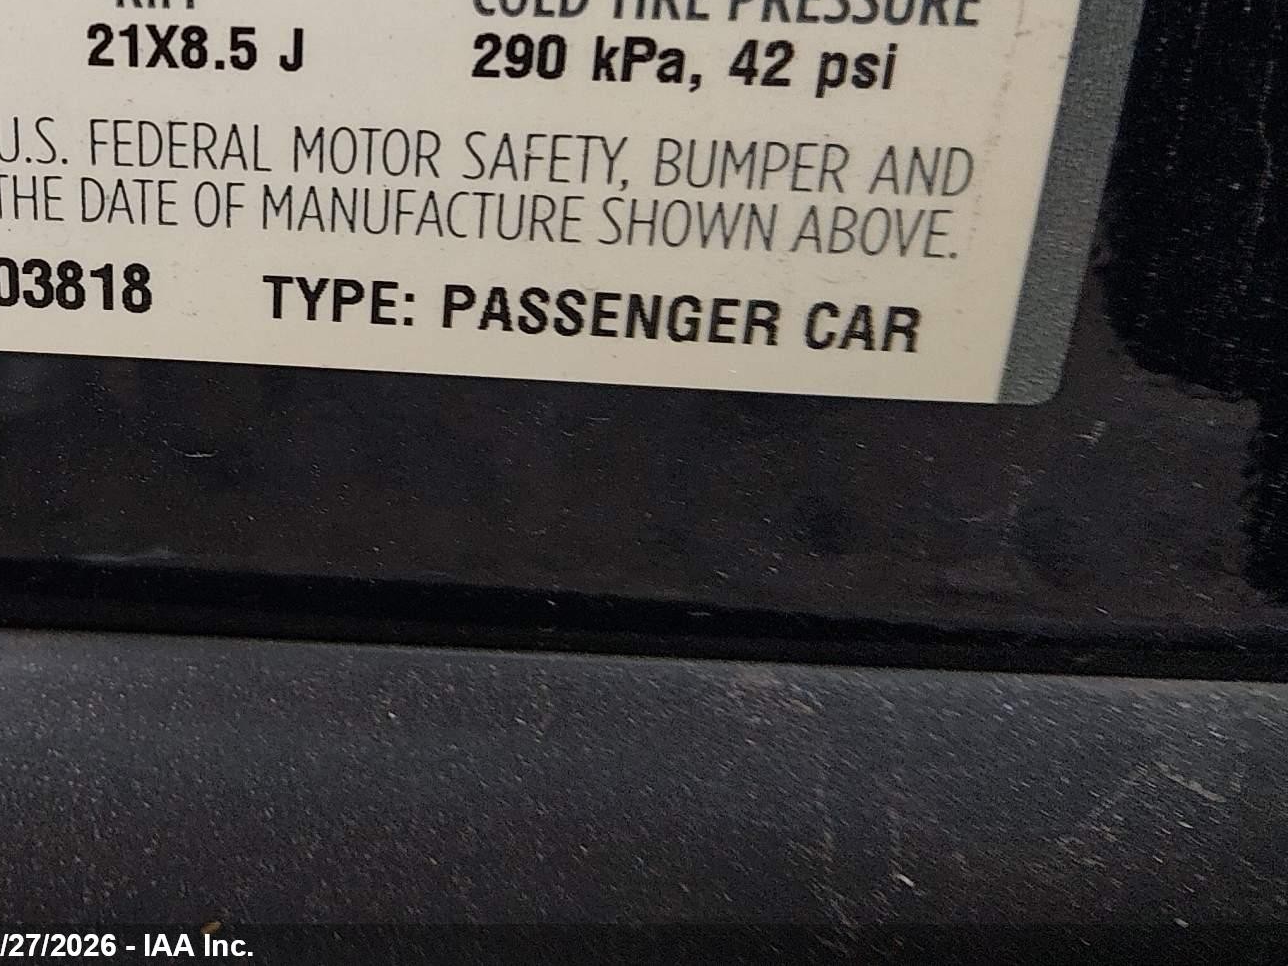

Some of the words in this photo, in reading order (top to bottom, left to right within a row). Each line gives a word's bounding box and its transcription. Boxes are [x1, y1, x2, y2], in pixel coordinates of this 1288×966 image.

[86, 22, 258, 71] 21X8.5
[278, 27, 305, 73] J
[470, 31, 568, 81] 290
[591, 34, 703, 94] kPa,
[727, 38, 796, 88] 42
[814, 42, 899, 99] psi
[89, 118, 273, 173] FEDERAL
[293, 125, 442, 179] MOTOR
[461, 130, 629, 192] SAFETY,
[654, 137, 851, 194] BUMPER
[867, 144, 975, 197] AND
[80, 176, 179, 227] DATE
[193, 180, 246, 229] OF
[262, 183, 585, 244] MANUFACTURE
[597, 196, 779, 252] SHOWN
[787, 204, 959, 260] ABOVE.
[261, 274, 416, 327] TYPE:
[441, 283, 783, 347] PASSENGER
[802, 300, 924, 354] CAR
